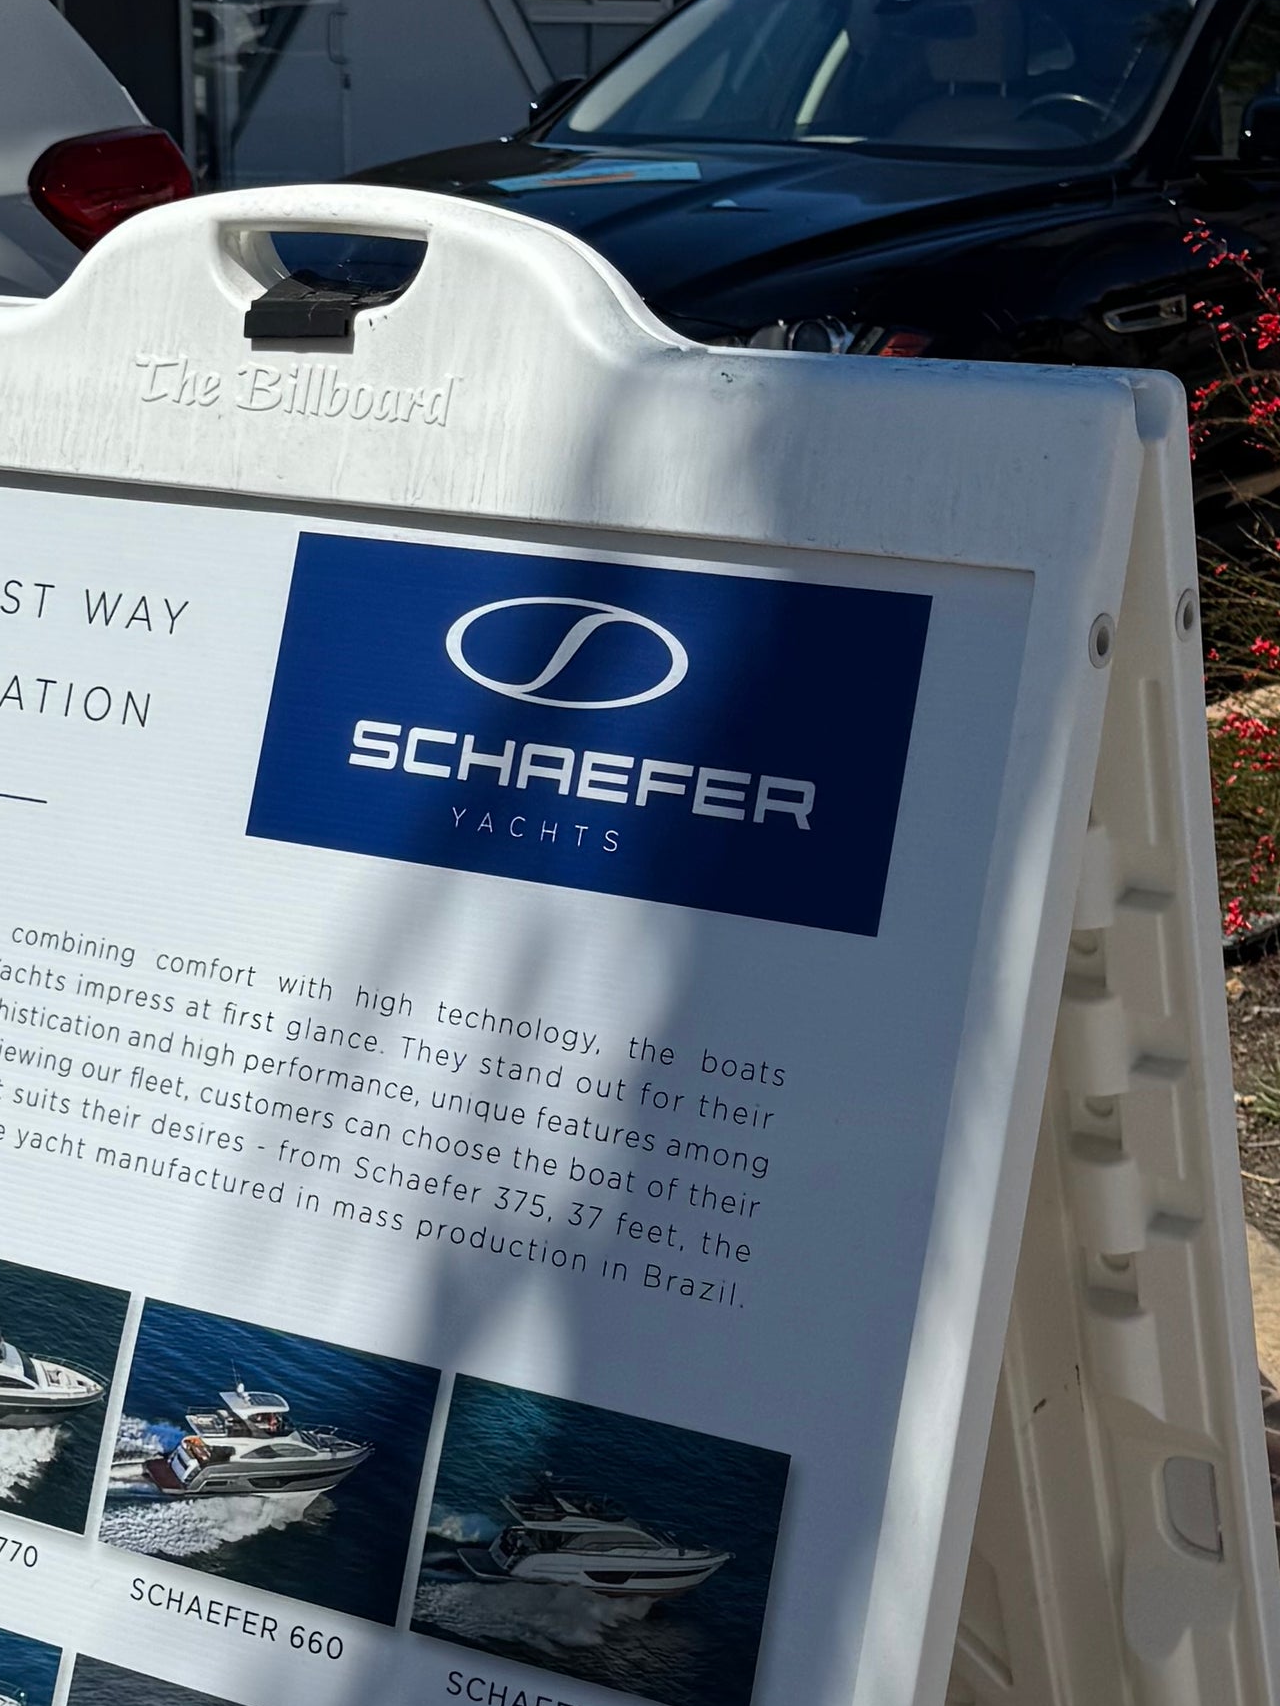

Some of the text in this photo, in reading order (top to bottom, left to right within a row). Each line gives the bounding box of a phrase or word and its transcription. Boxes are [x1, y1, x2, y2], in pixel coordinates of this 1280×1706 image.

[134, 351, 465, 428] The Billboard
[84, 588, 190, 635] WAY
[347, 718, 817, 831] SCHAEFER
[451, 805, 620, 853] YACHTS
[10, 926, 136, 969] combining
[155, 953, 257, 988] comfort
[277, 975, 333, 1002] with
[354, 983, 413, 1018] high
[436, 1000, 600, 1056] technology,
[628, 1035, 675, 1067] the
[700, 1047, 786, 1088] boats
[75, 972, 176, 1014] impress
[184, 998, 212, 1021] at
[222, 1000, 275, 1033] first
[284, 1016, 384, 1055] glance.
[400, 1035, 468, 1074] They
[478, 1055, 564, 1089] stand
[575, 1075, 627, 1103] out
[635, 1081, 686, 1113] for
[697, 1093, 776, 1130] their
[11, 1086, 71, 1115] suits
[81, 1097, 142, 1129] their
[150, 1112, 244, 1153] desires
[277, 1138, 341, 1174] from
[353, 1155, 483, 1204] Schaefer
[492, 1185, 552, 1224] 375,
[566, 1200, 604, 1230] 37
[615, 1211, 685, 1253] feet,
[701, 1230, 752, 1264] the
[80, 1061, 123, 1084] our
[129, 1065, 189, 1102] fleet,
[199, 1085, 335, 1130] customers
[343, 1116, 391, 1142] can
[401, 1124, 501, 1165] choose
[512, 1146, 558, 1177] the
[568, 1155, 637, 1194] boat
[646, 1176, 680, 1202] of
[687, 1182, 761, 1219] their
[127, 1029, 175, 1054] and
[180, 1034, 235, 1068] high
[242, 1053, 420, 1108] performance,
[430, 1090, 526, 1126] unique
[535, 1105, 657, 1153] features
[665, 1137, 770, 1180] among
[13, 1127, 87, 1160] yacht
[95, 1146, 285, 1204] manufactured
[295, 1185, 320, 1213] in
[331, 1199, 404, 1232] mass
[415, 1218, 587, 1273] production
[601, 1258, 628, 1283] in
[642, 1263, 744, 1309] Brazil.
[129, 1576, 344, 1661] SCHAEFER 660
